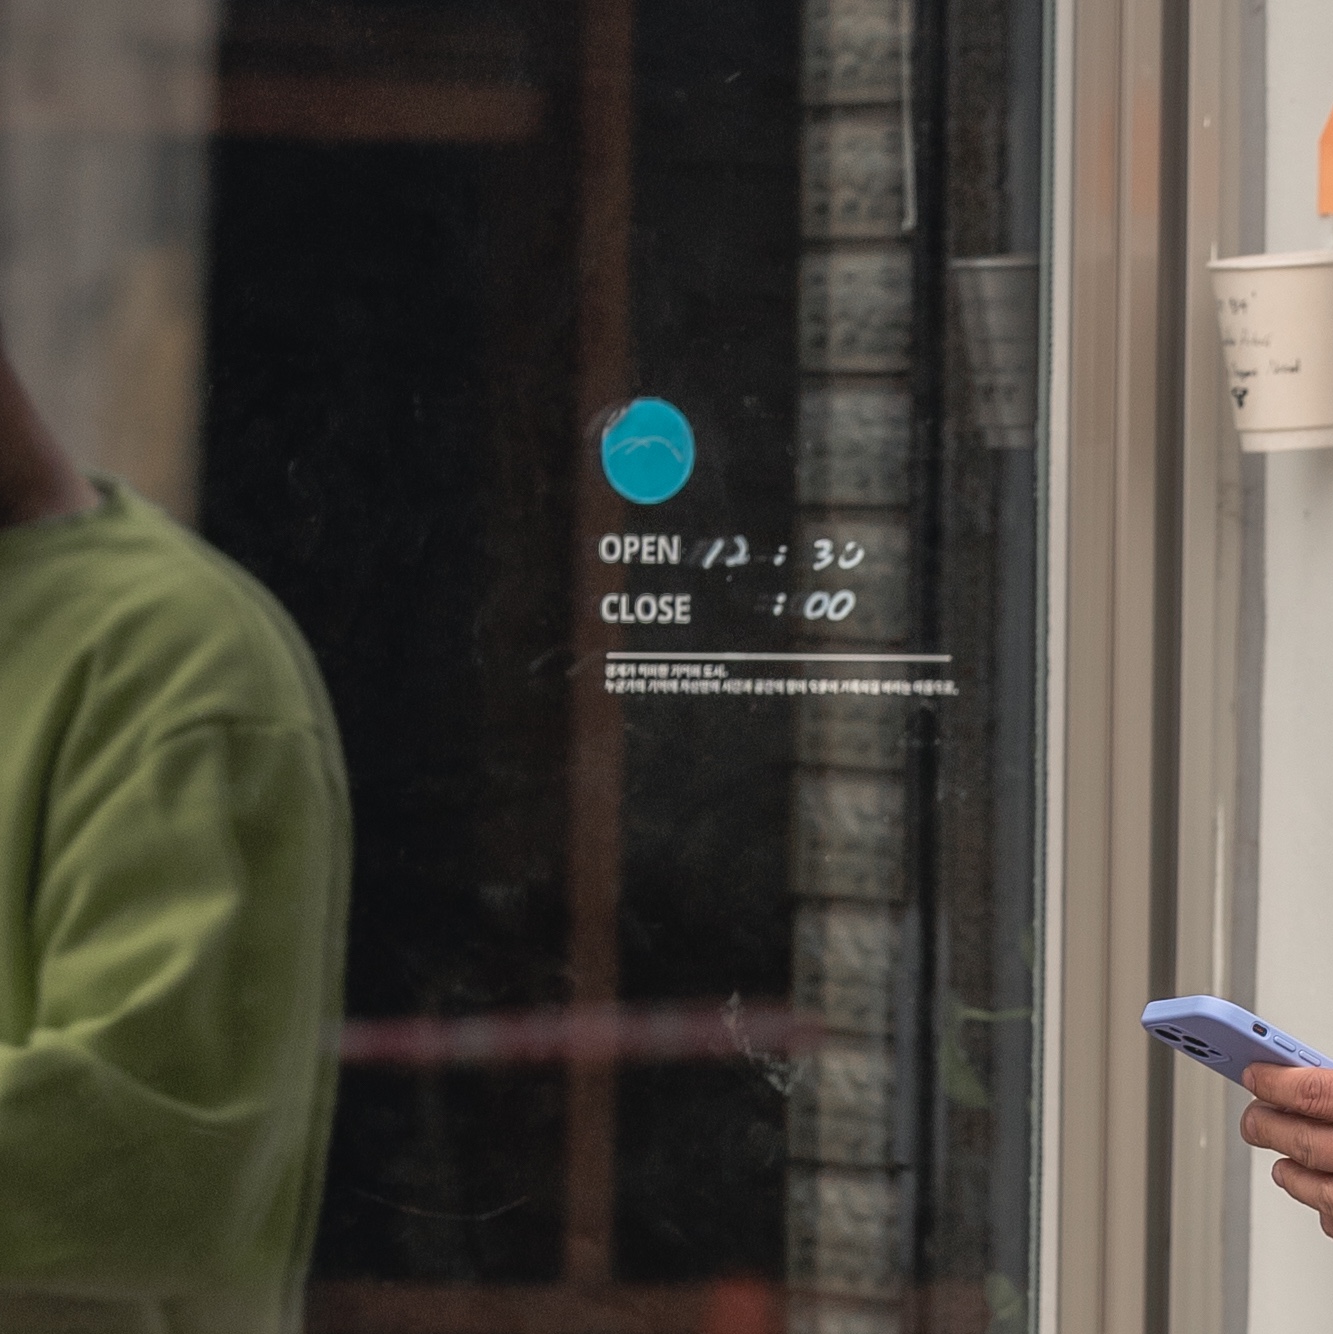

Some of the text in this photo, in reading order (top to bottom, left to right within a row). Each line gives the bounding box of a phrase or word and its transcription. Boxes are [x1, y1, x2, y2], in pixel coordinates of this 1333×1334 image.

[600, 533, 682, 564] OPEN
[702, 534, 750, 569] 12
[812, 539, 866, 571] 30
[601, 593, 692, 624] CLOSE
[803, 589, 857, 621] 00
